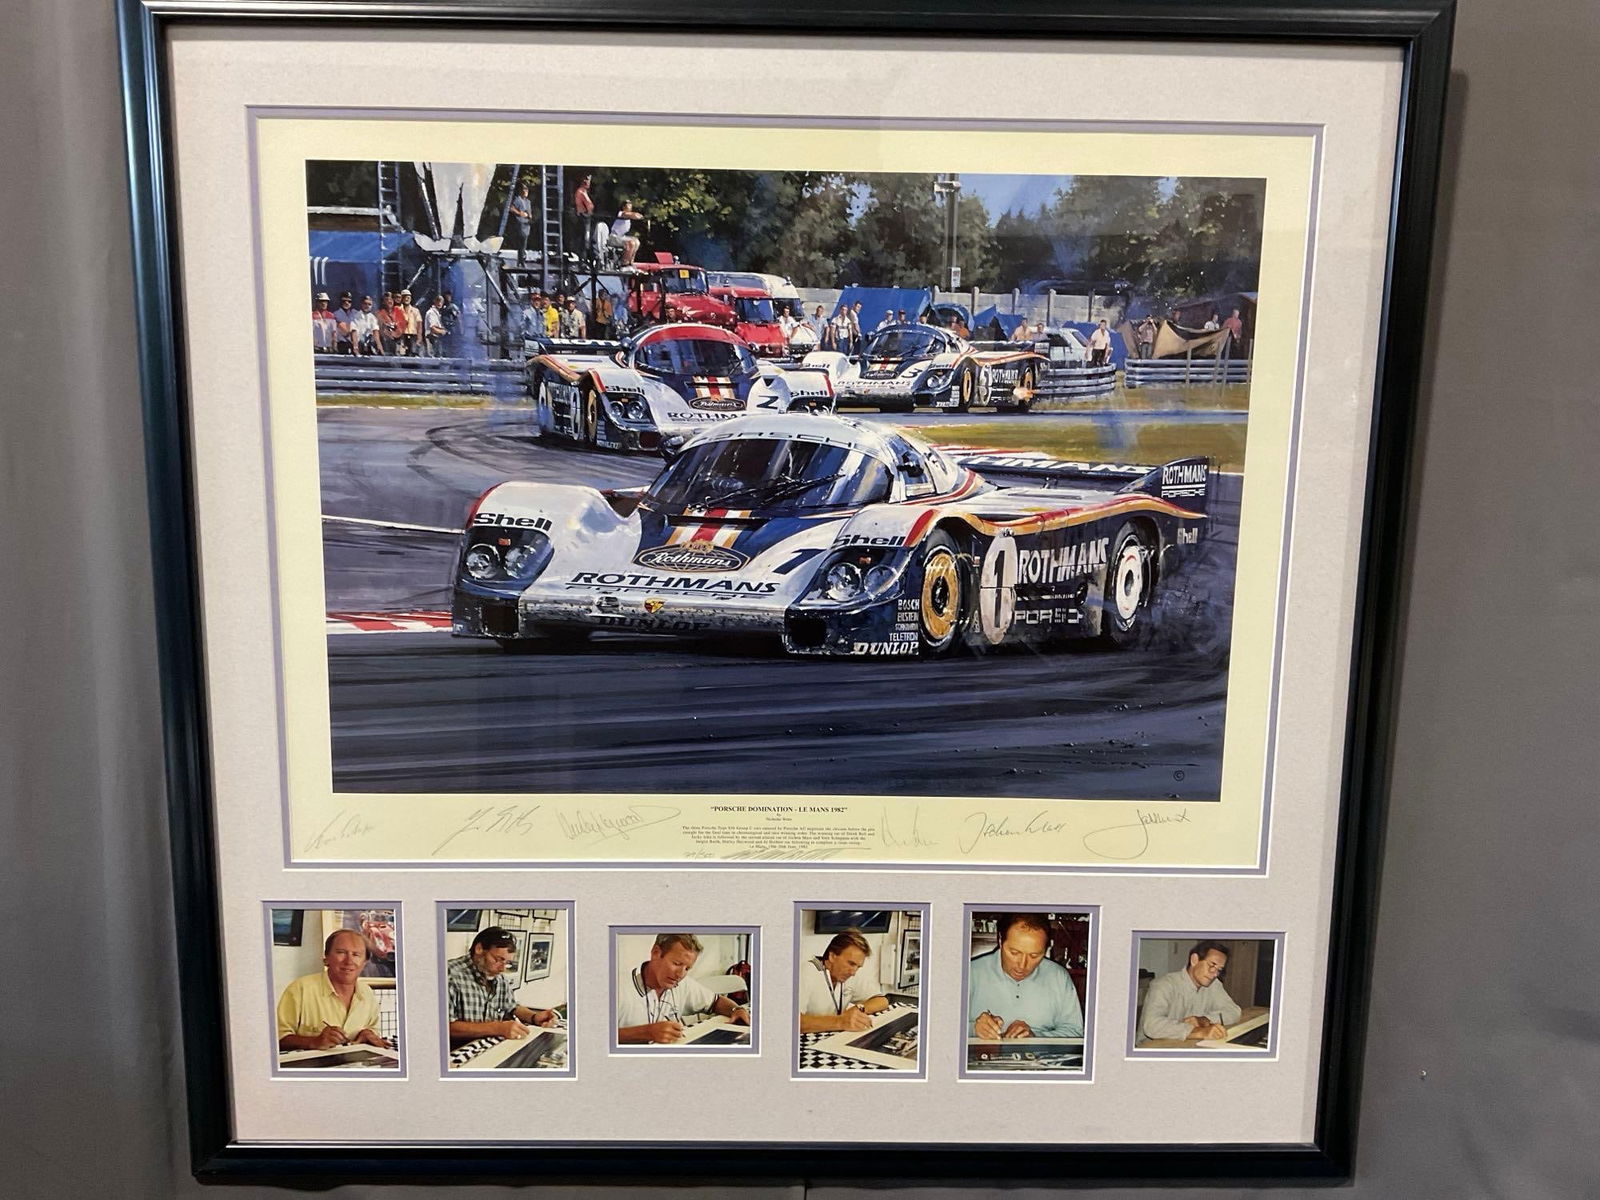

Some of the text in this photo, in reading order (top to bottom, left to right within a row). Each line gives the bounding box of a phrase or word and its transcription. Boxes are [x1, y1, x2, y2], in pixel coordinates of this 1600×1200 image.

[901, 366, 923, 378] 3
[756, 395, 779, 409] 2
[1162, 465, 1207, 485] ROTHMANS
[1161, 488, 1206, 498] PORSCHE
[474, 512, 552, 532] Shell
[831, 534, 906, 549] Shell
[648, 551, 732, 569] Rothmans
[1018, 537, 1110, 584] ROTHMANS
[571, 572, 780, 593] ROTHMANS
[993, 549, 1005, 628] 1
[853, 641, 919, 655] DUNLOP
